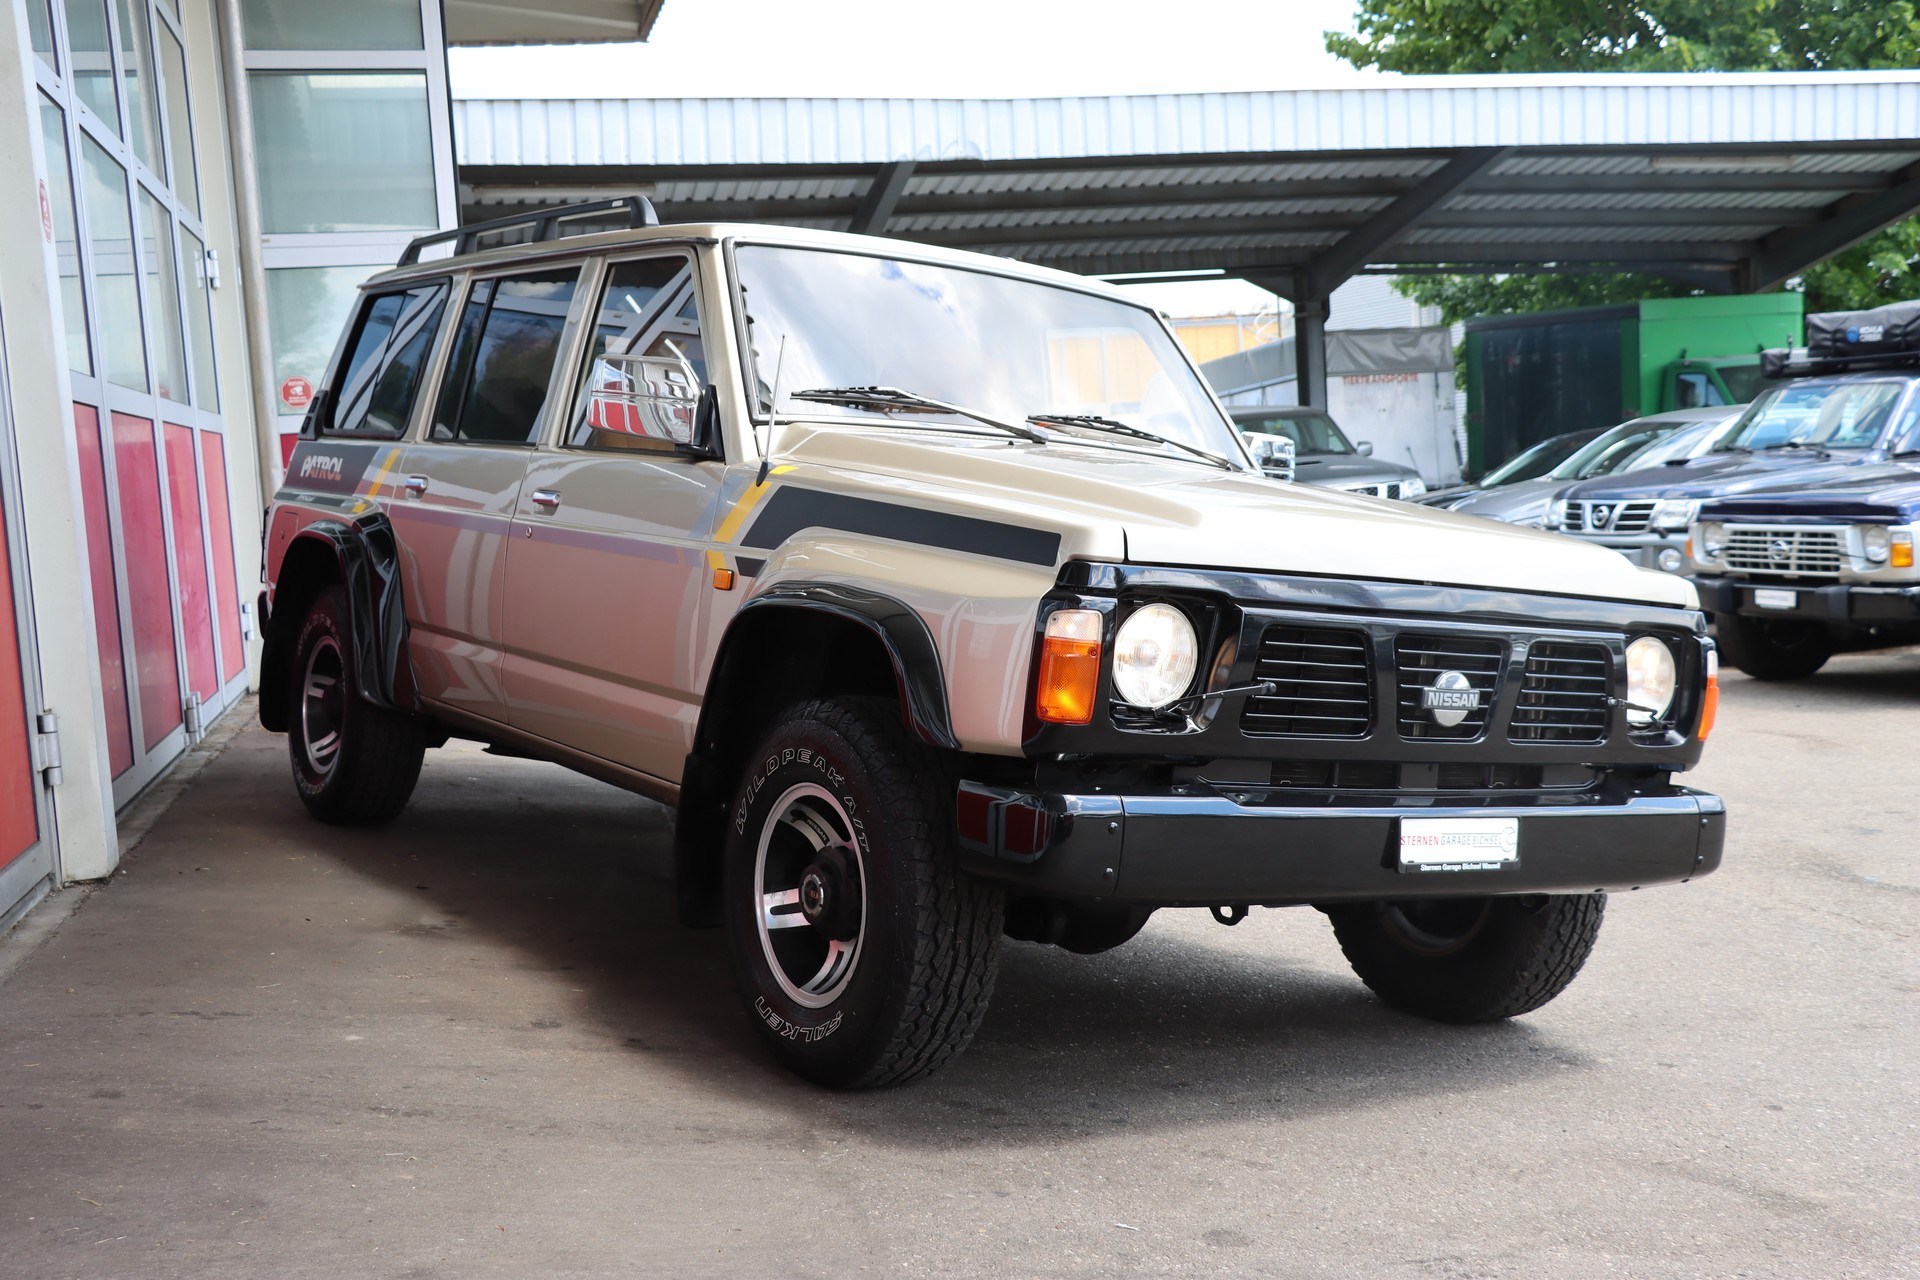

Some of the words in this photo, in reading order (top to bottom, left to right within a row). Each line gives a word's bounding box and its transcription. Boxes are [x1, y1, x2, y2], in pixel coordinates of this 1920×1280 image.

[300, 455, 344, 481] PATROL
[1427, 691, 1479, 707] NISSAN
[735, 748, 842, 835] WILDPEAK
[806, 819, 828, 841] NISSAN
[1400, 836, 1439, 846] STERNEN
[1440, 835, 1470, 846] GARAGE
[1472, 835, 1502, 845] BICHSEL
[1420, 864, 1442, 872] Sternen
[1442, 863, 1462, 872] Garage
[755, 996, 844, 1042] FALKEN
